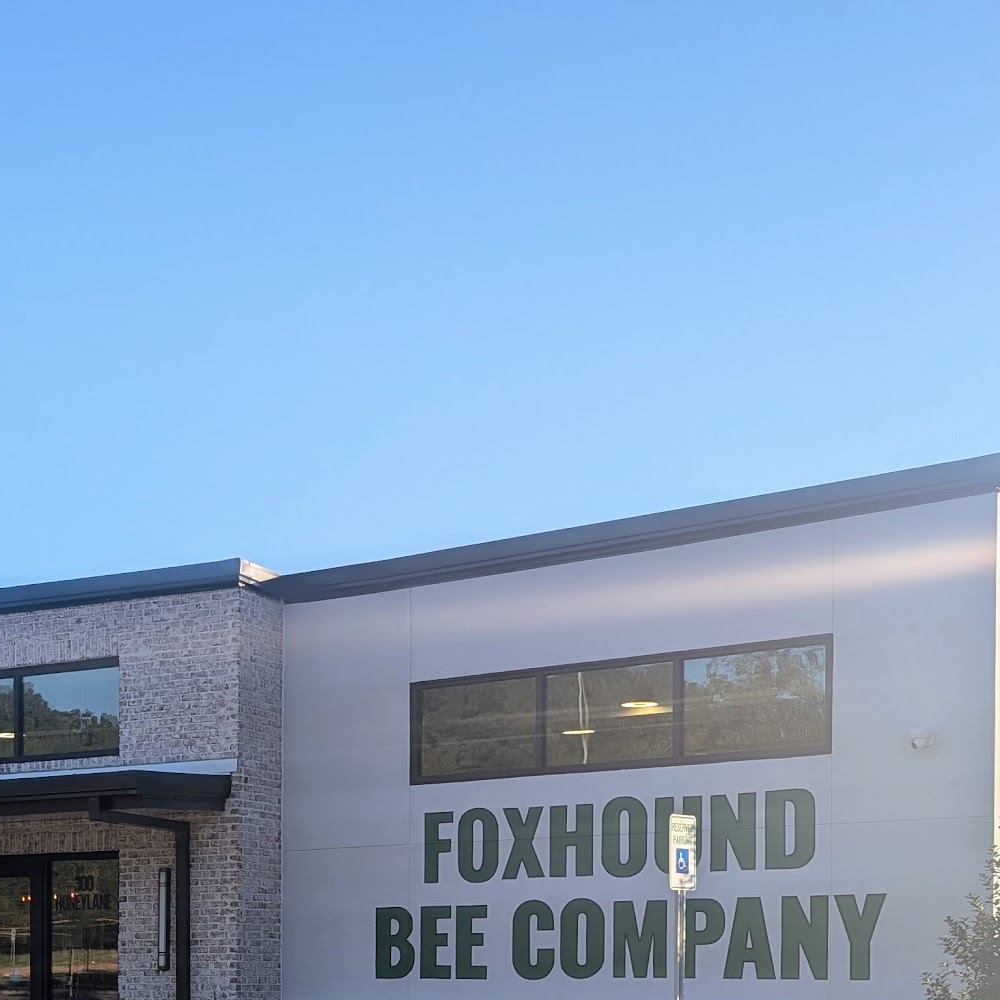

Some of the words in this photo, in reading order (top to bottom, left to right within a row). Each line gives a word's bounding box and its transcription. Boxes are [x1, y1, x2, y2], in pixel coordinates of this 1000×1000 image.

[423, 788, 816, 884] FOXHOUND
[673, 835, 693, 846] PARKING
[74, 875, 94, 891] 300
[375, 904, 488, 980] BEE
[512, 893, 888, 981] COMPANY
